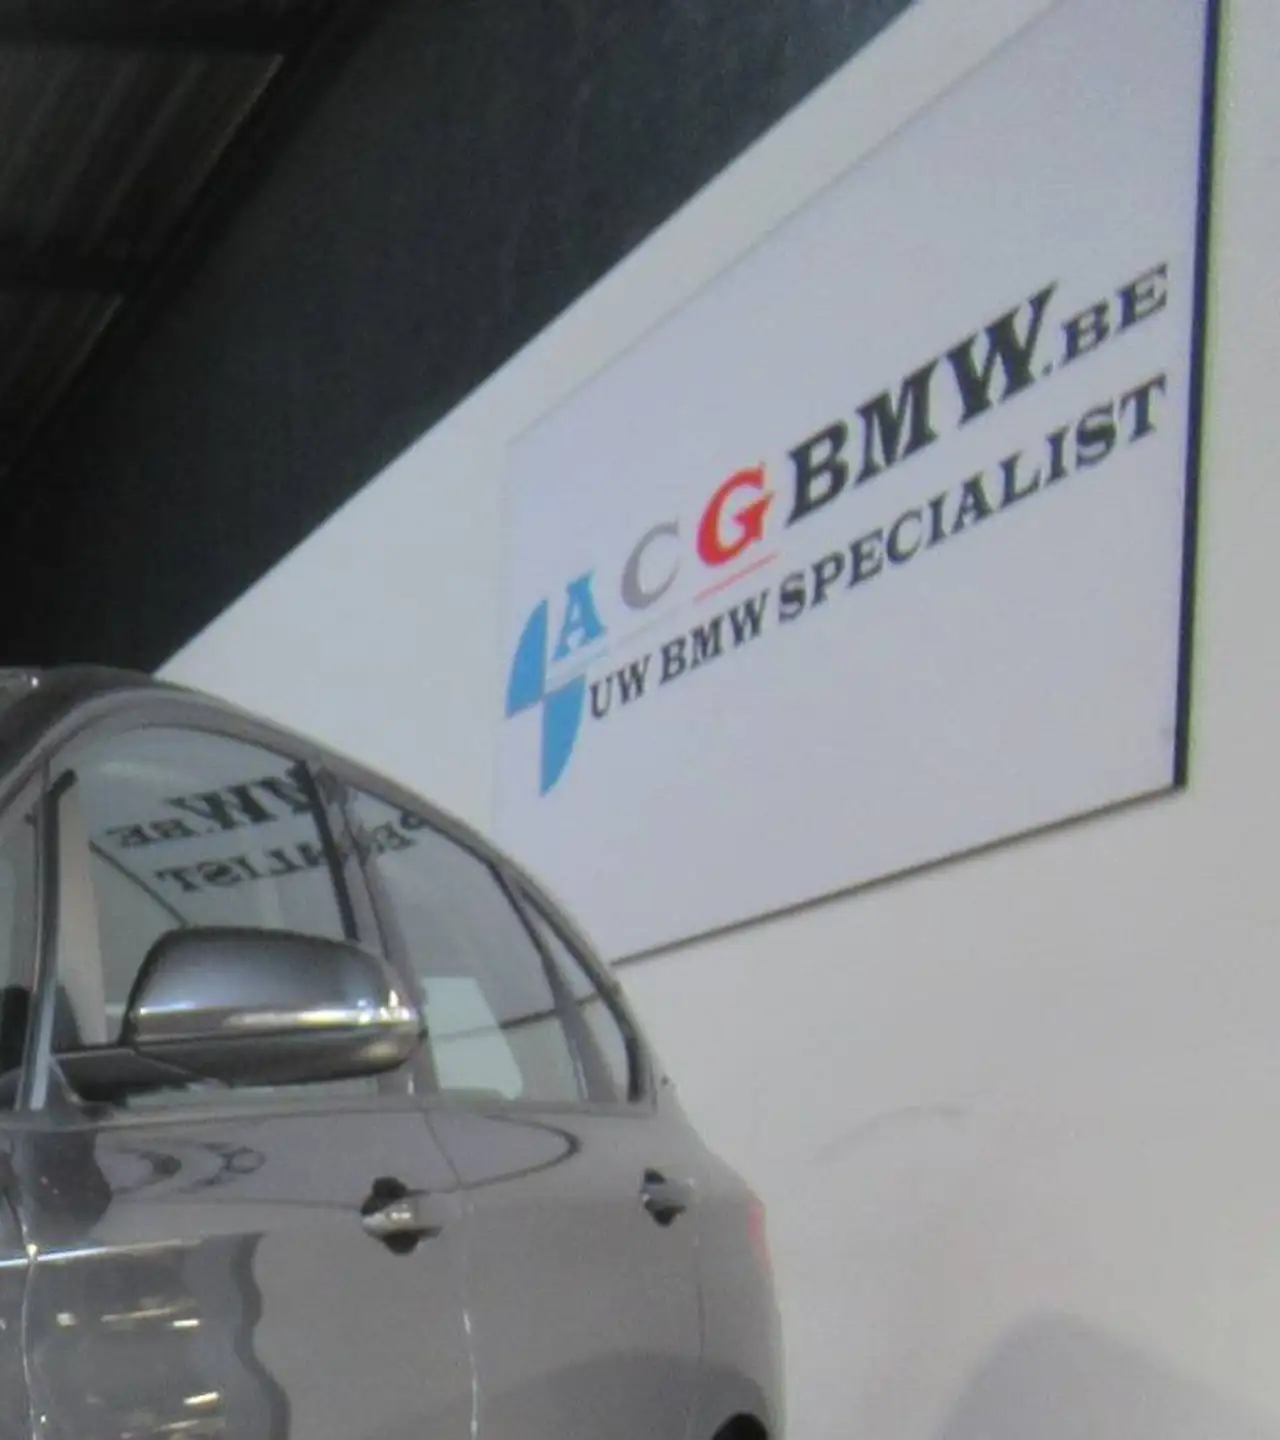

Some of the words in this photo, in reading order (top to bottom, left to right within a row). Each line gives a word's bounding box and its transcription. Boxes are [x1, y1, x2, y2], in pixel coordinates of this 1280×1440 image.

[589, 655, 653, 720] UW
[659, 590, 770, 686] BMW
[778, 374, 1167, 622] SPECIALIST
